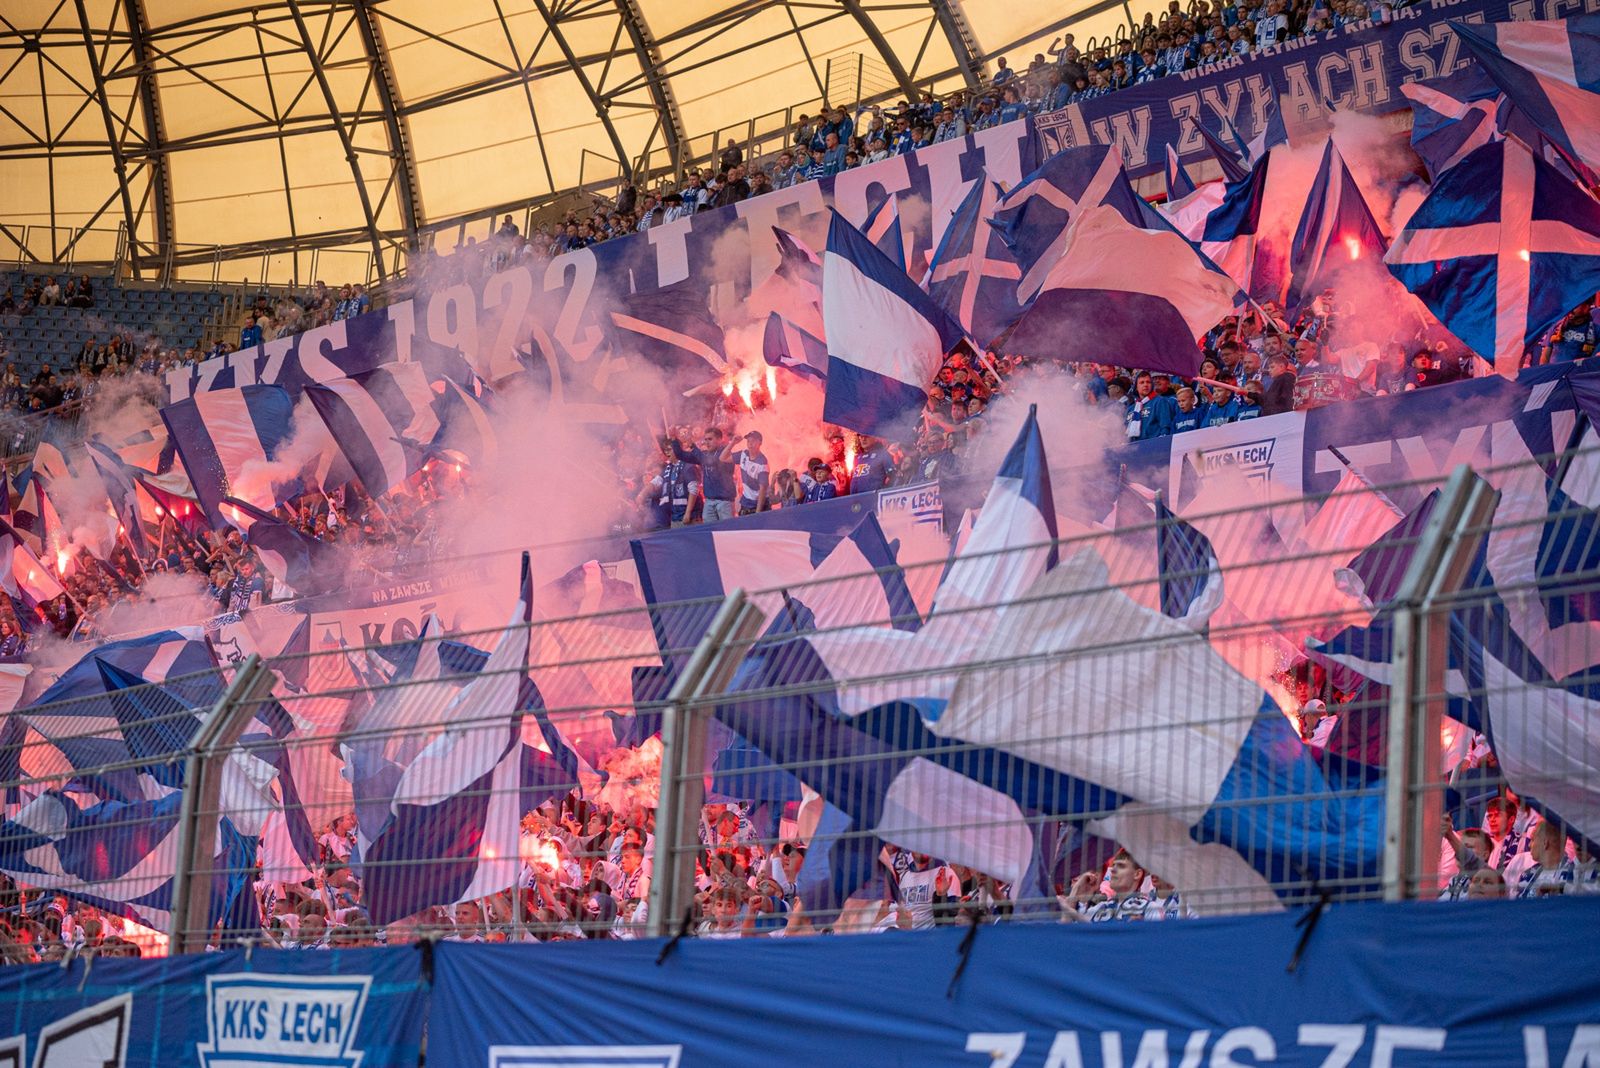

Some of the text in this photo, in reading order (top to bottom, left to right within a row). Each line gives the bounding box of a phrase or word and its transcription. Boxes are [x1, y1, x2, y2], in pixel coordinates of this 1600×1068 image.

[1178, 55, 1244, 82] WIARA
[1053, 112, 1067, 122] LECH
[386, 246, 605, 381] 1922
[1236, 446, 1267, 464] LECH
[911, 490, 942, 510] LECH
[371, 590, 388, 603] NA
[389, 580, 433, 600] ZAWSZE
[221, 999, 343, 1044] KKS LECH
